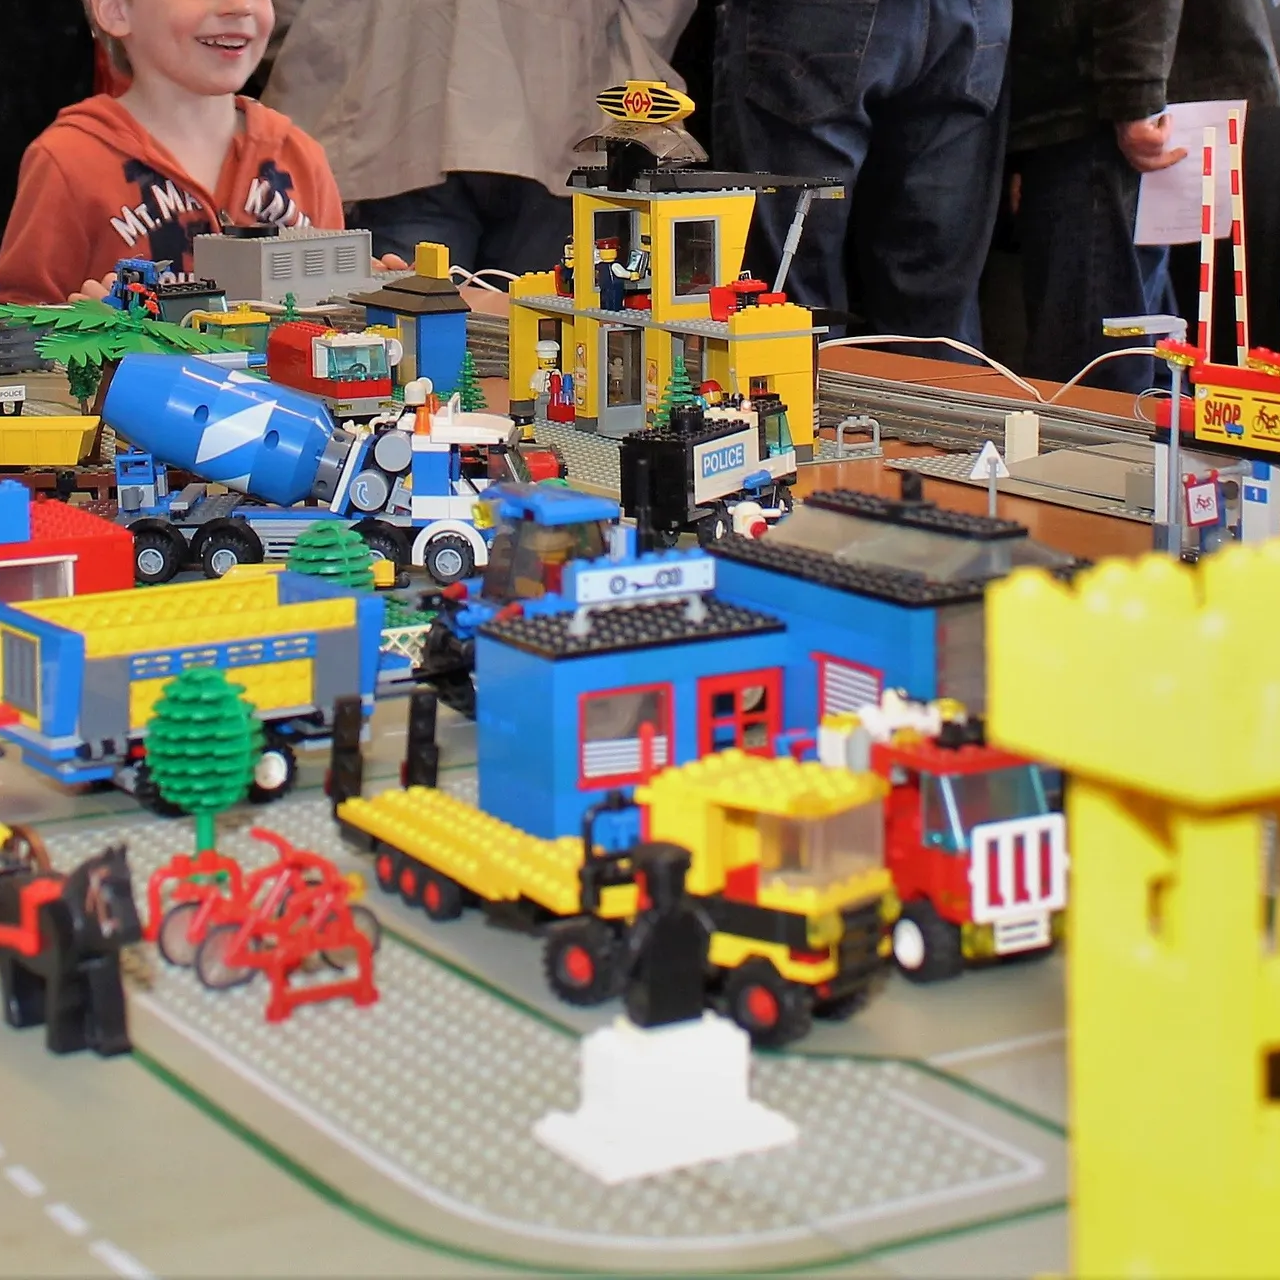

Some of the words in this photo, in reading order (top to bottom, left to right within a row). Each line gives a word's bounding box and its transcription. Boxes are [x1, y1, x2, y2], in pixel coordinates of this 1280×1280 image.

[0, 390, 23, 398] POLICE
[1204, 399, 1242, 427] SHOP
[702, 445, 743, 475] POLICE
[1251, 489, 1259, 500] 1
